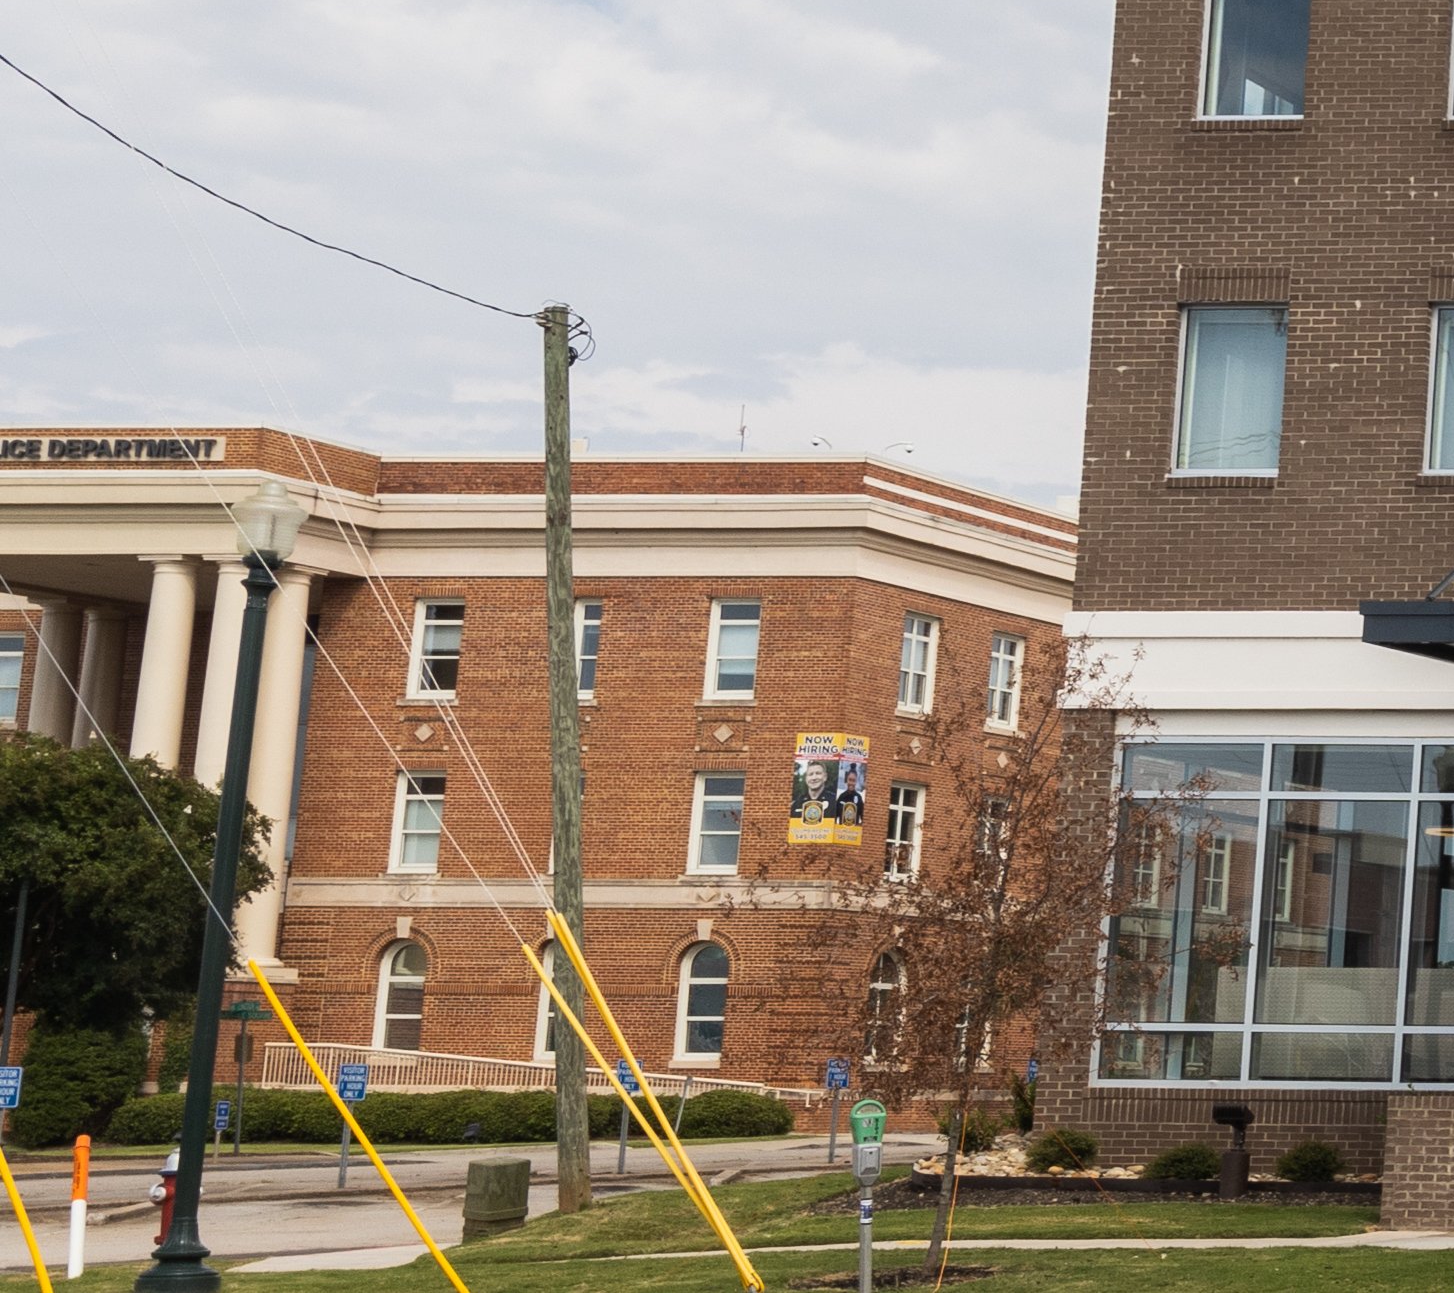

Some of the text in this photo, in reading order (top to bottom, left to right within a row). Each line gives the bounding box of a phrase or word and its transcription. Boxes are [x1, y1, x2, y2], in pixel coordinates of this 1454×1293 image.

[0, 439, 217, 460] ICE DEPARTMENT
[805, 736, 834, 744] NOW
[846, 738, 864, 746] NOW
[798, 745, 838, 754] HIRING
[842, 747, 866, 757] HIRING
[341, 1074, 365, 1082] PARKING
[347, 1082, 363, 1090] HOUR
[343, 1090, 359, 1098] ONLY
